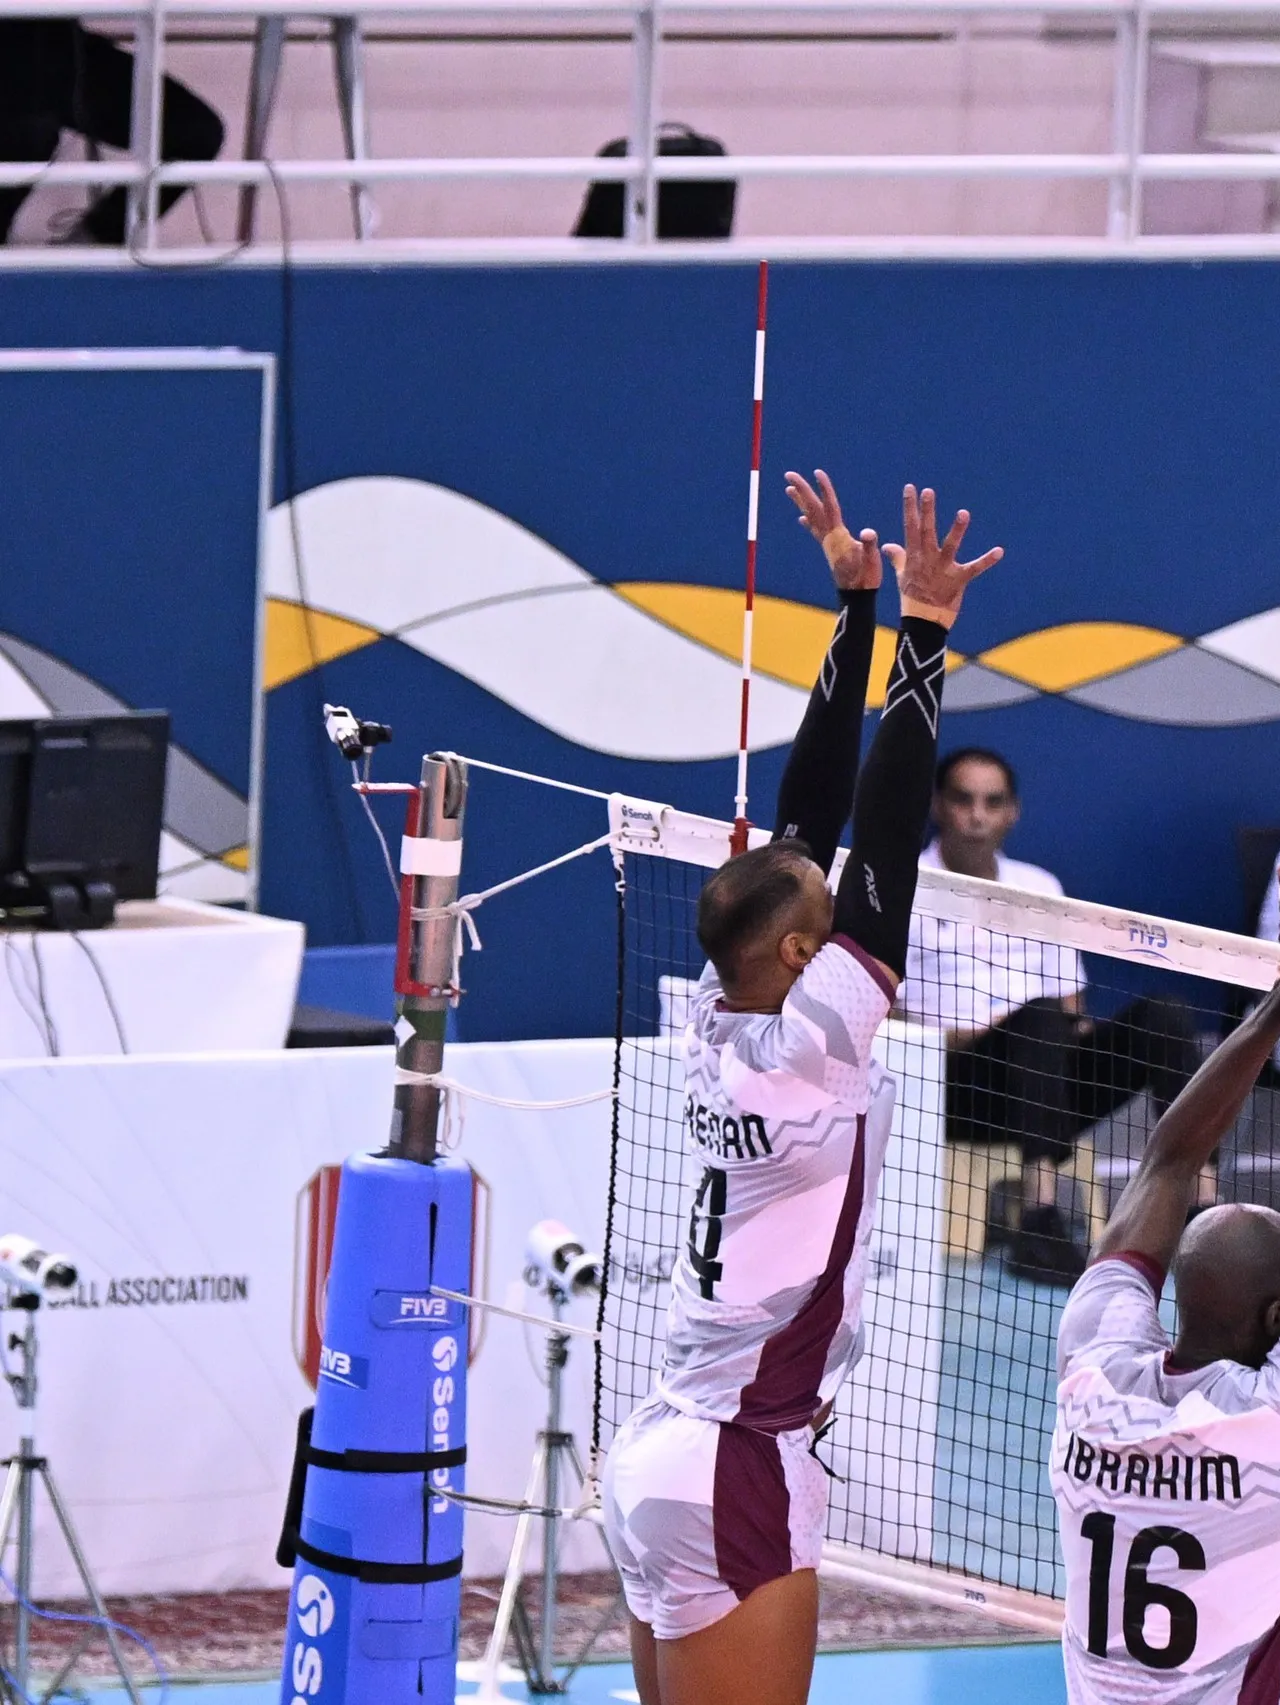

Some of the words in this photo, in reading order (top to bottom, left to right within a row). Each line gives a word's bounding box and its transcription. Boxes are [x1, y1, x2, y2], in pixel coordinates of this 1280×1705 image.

[628, 808, 654, 820] Senoh
[105, 1274, 248, 1307] ASSOCIATION
[400, 1297, 448, 1317] FIVB
[1063, 1431, 1242, 1501] IBRAHIM
[1080, 1511, 1207, 1669] 16
